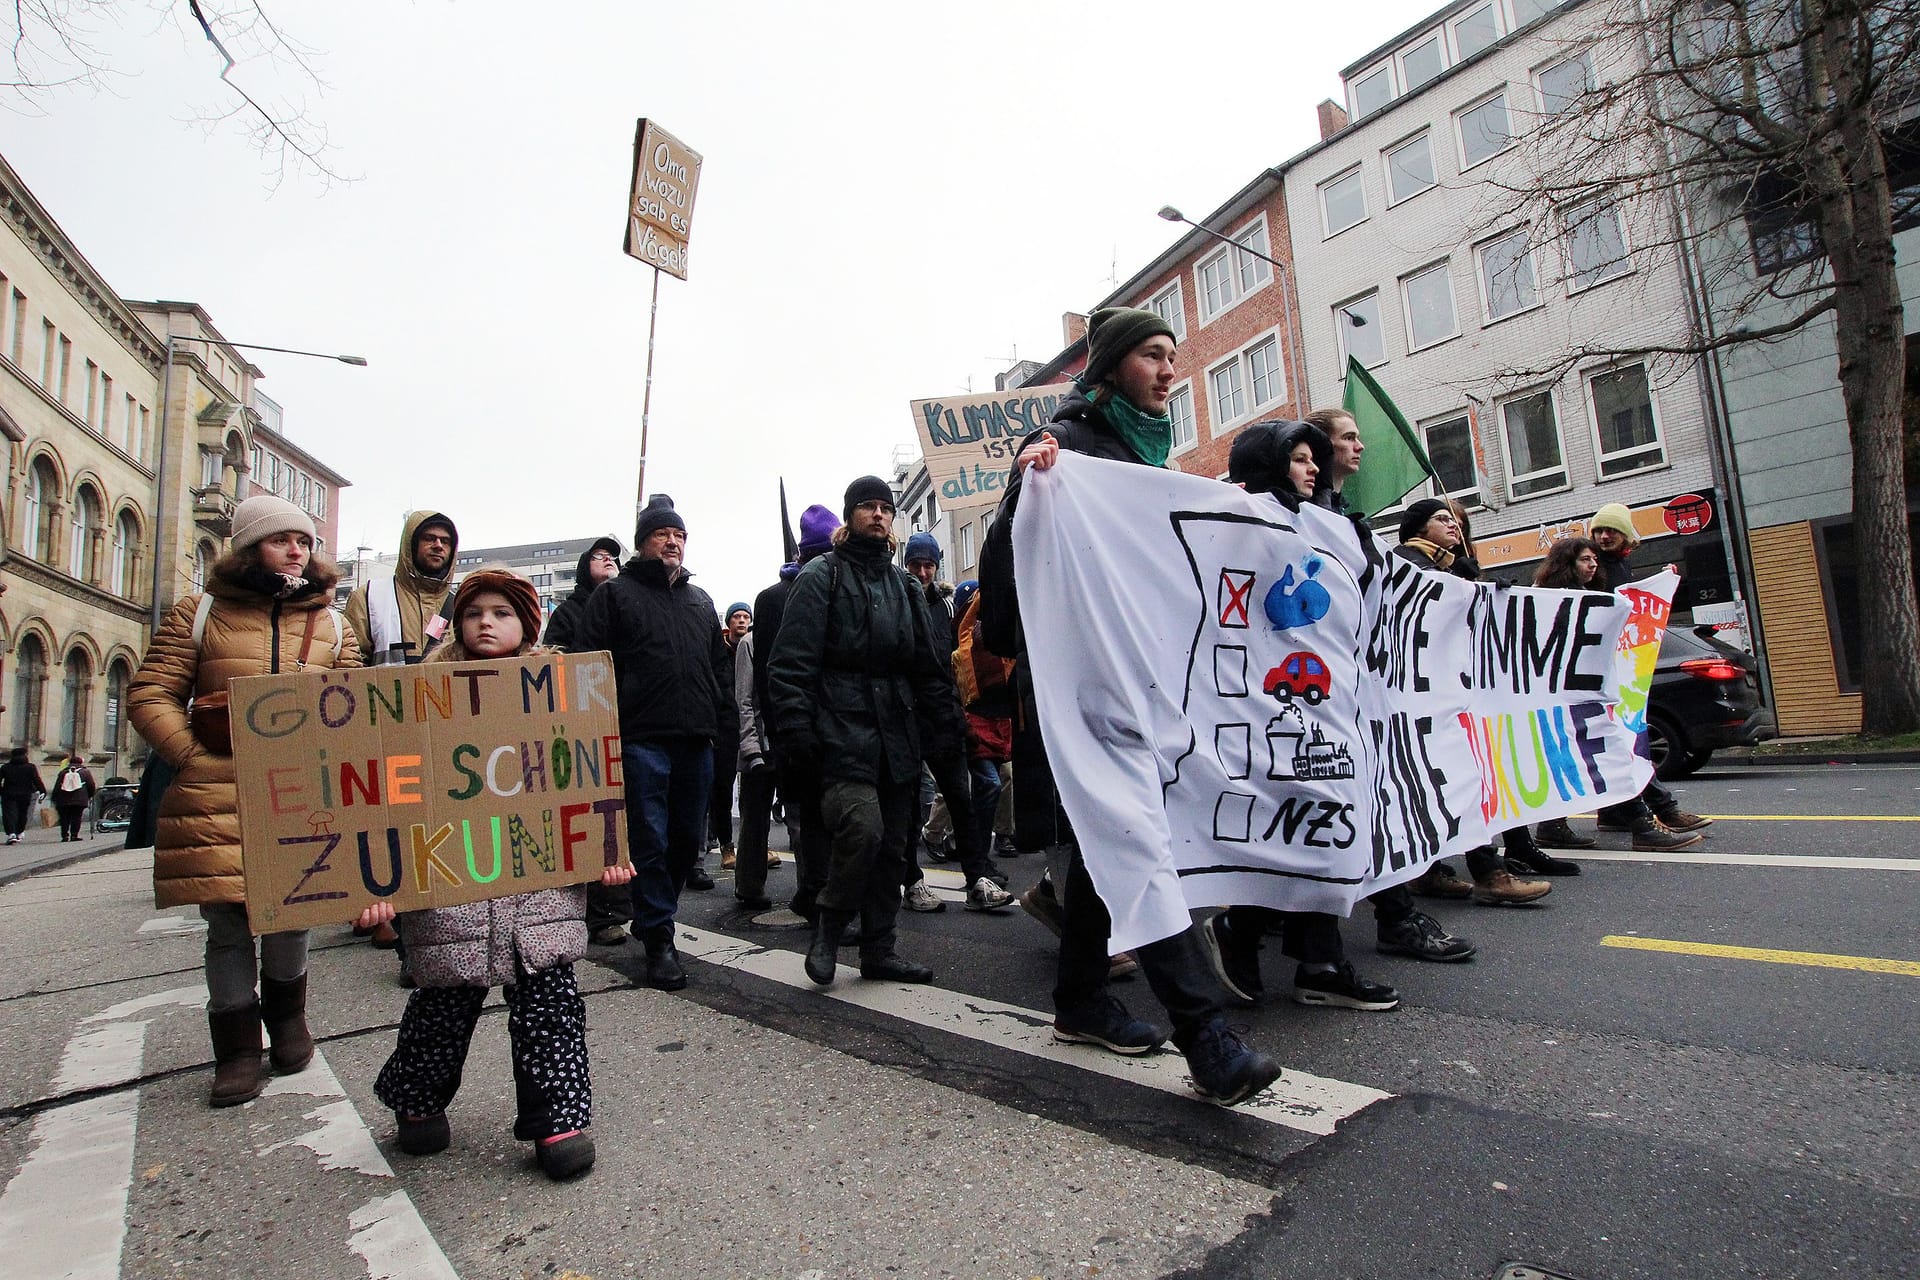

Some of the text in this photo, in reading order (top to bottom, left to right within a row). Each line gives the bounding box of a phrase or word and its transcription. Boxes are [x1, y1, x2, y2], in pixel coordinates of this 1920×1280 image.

[637, 195, 688, 235] gab es
[922, 393, 1066, 447] KLIMASCH
[982, 437, 1016, 459] IST
[1699, 588, 1718, 600] 32
[246, 669, 499, 738] GÖNNT
[448, 725, 624, 801] SCHÖNE
[1262, 797, 1356, 849] NZS
[278, 800, 625, 906] ZUKUNFT
